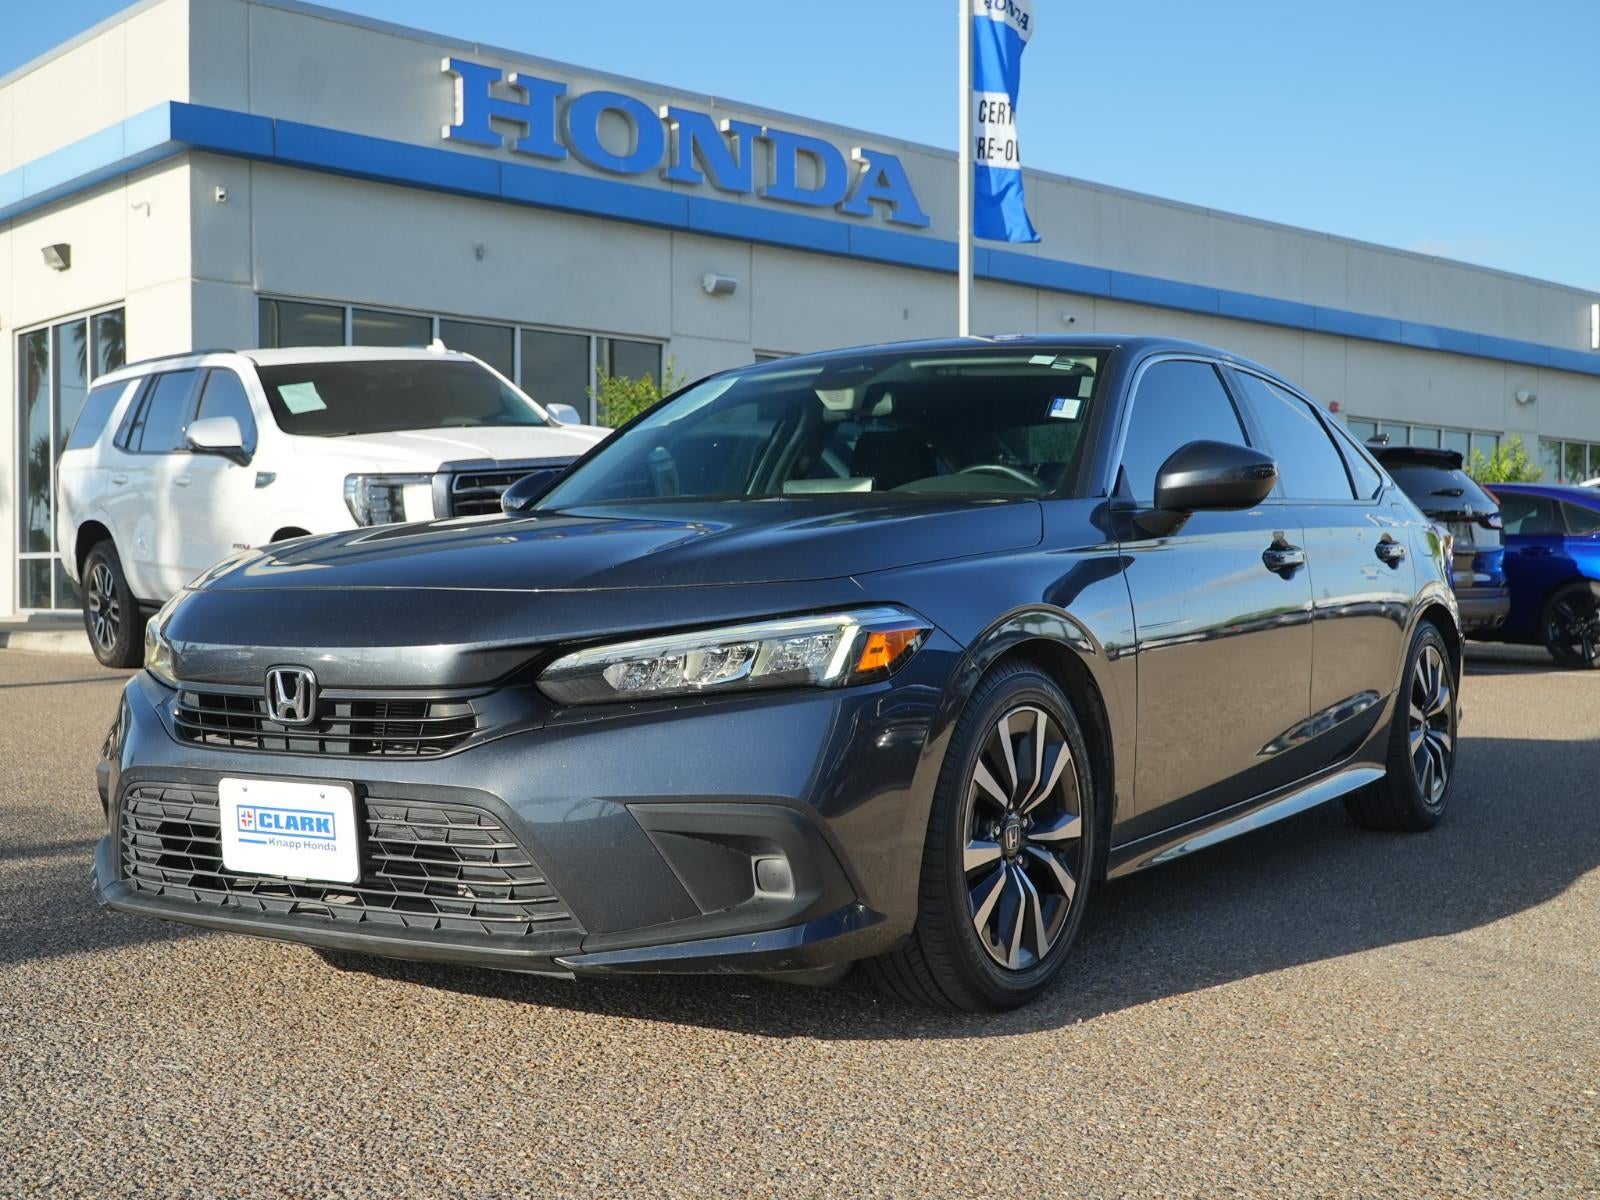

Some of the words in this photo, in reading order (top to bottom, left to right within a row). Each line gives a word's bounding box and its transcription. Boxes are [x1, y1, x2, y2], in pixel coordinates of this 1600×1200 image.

[441, 57, 931, 228] HONDA
[975, 136, 1020, 162] RE-O
[258, 812, 331, 834] CLARK
[268, 837, 302, 851] Knapp
[303, 839, 337, 853] Honda
